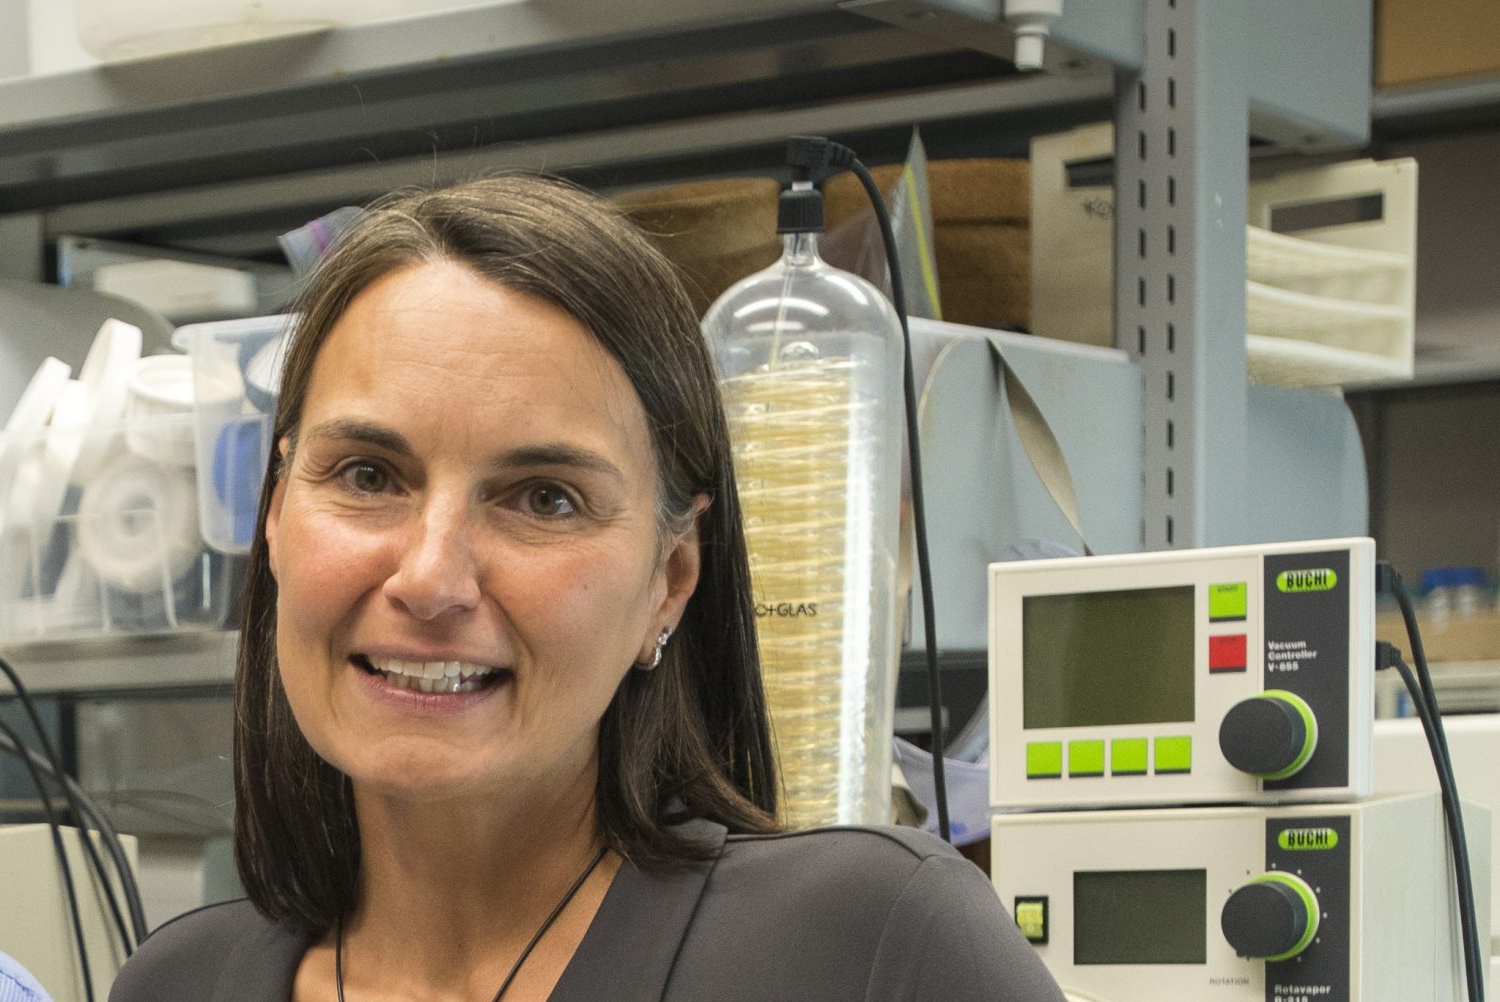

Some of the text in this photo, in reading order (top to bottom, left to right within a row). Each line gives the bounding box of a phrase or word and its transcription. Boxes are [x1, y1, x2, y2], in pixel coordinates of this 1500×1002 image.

[1286, 571, 1327, 589] BUCHI
[1268, 641, 1306, 650] Vacuum
[1268, 650, 1317, 660] Controller
[1287, 829, 1328, 846] BUCHI
[1274, 984, 1332, 996] Rotavapor
